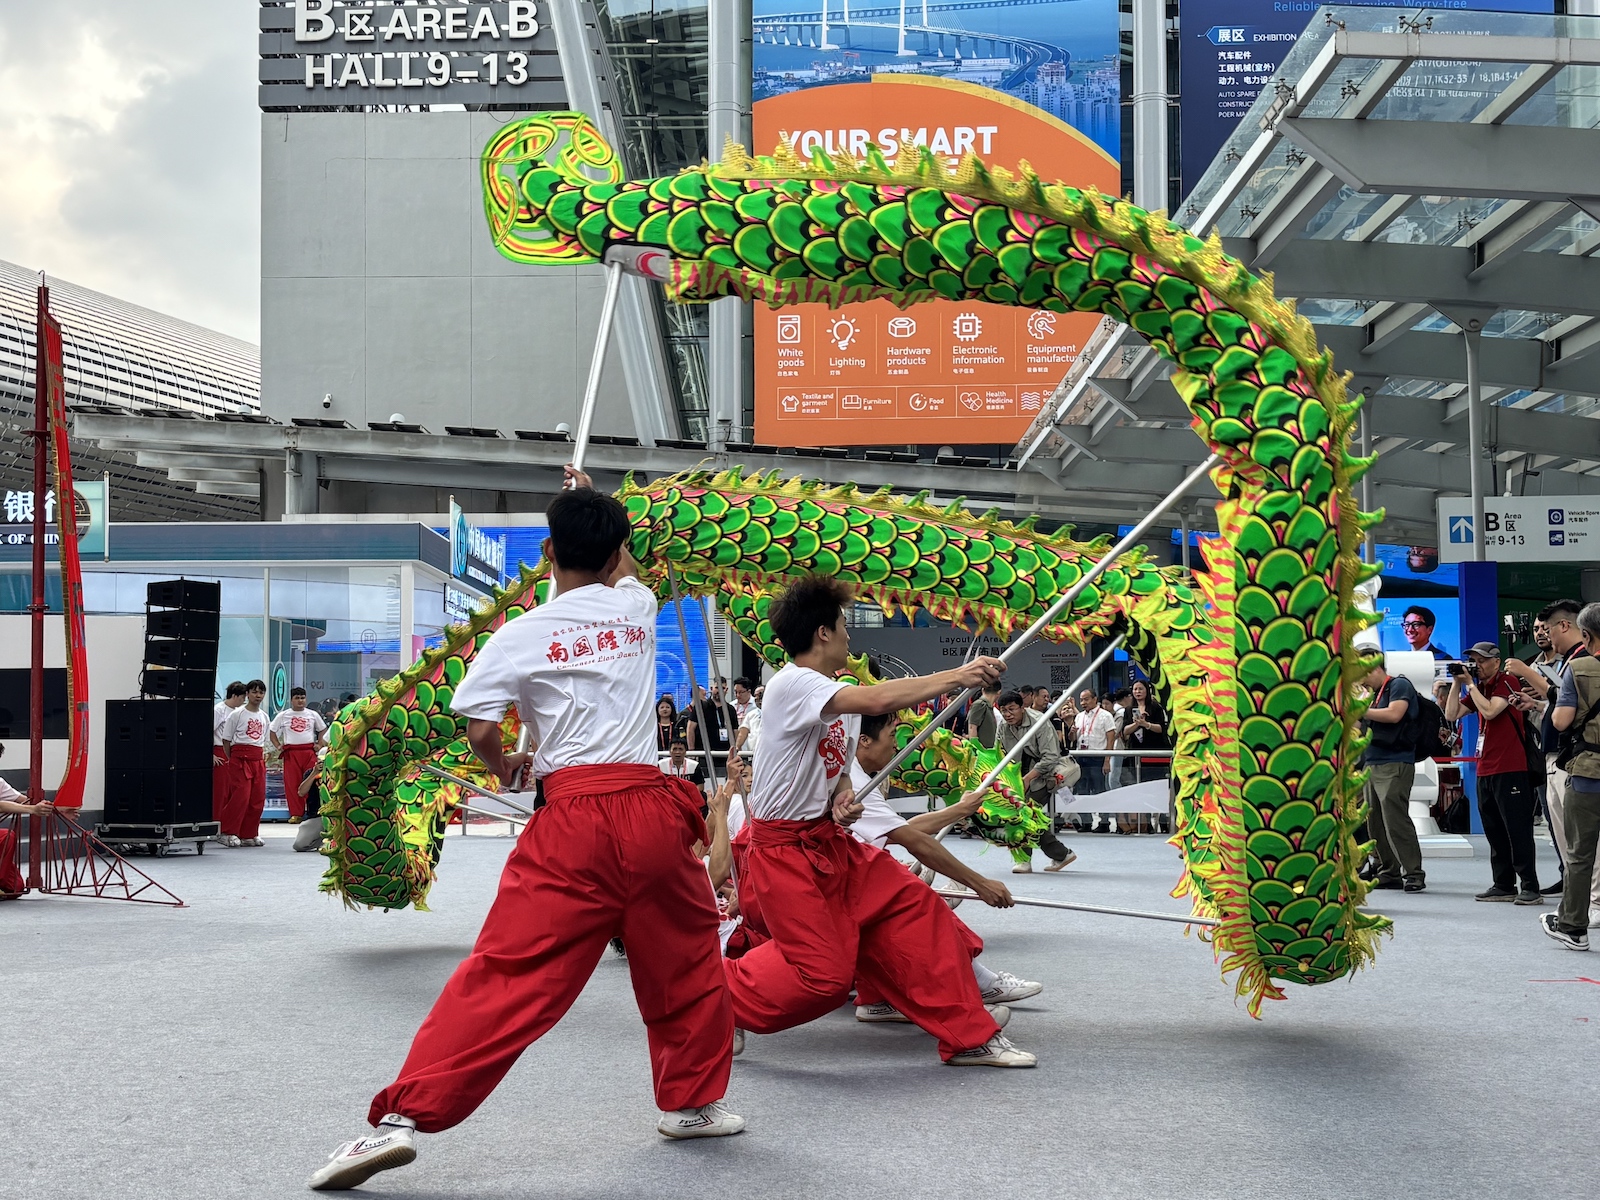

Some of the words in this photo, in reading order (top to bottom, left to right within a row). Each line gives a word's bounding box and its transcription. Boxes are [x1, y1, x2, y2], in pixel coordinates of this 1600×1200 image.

[295, 0, 336, 42] B
[384, 7, 501, 41] AREA
[508, 0, 540, 39] B
[1217, 28, 1246, 43] 展区
[1253, 33, 1297, 42] EXHIBITION
[1217, 51, 1252, 61] 汽车配件
[305, 53, 424, 89] HALL
[777, 348, 804, 357] White
[886, 346, 931, 356] Hardware
[952, 345, 998, 355] Electronic
[1026, 344, 1076, 355] Equipment
[777, 359, 805, 369] goods
[829, 357, 866, 368] Lighting
[886, 356, 927, 367] products
[952, 355, 1005, 365] information
[985, 390, 1007, 398] Health
[862, 397, 892, 405] Furniture
[928, 397, 945, 405] Food
[985, 397, 1014, 405] Medicine
[1484, 512, 1500, 532] B
[1504, 512, 1522, 520] Area
[1505, 520, 1517, 532] 区
[7, 533, 27, 545] OF
[1498, 534, 1525, 546] 9-13
[940, 635, 970, 645] Layout
